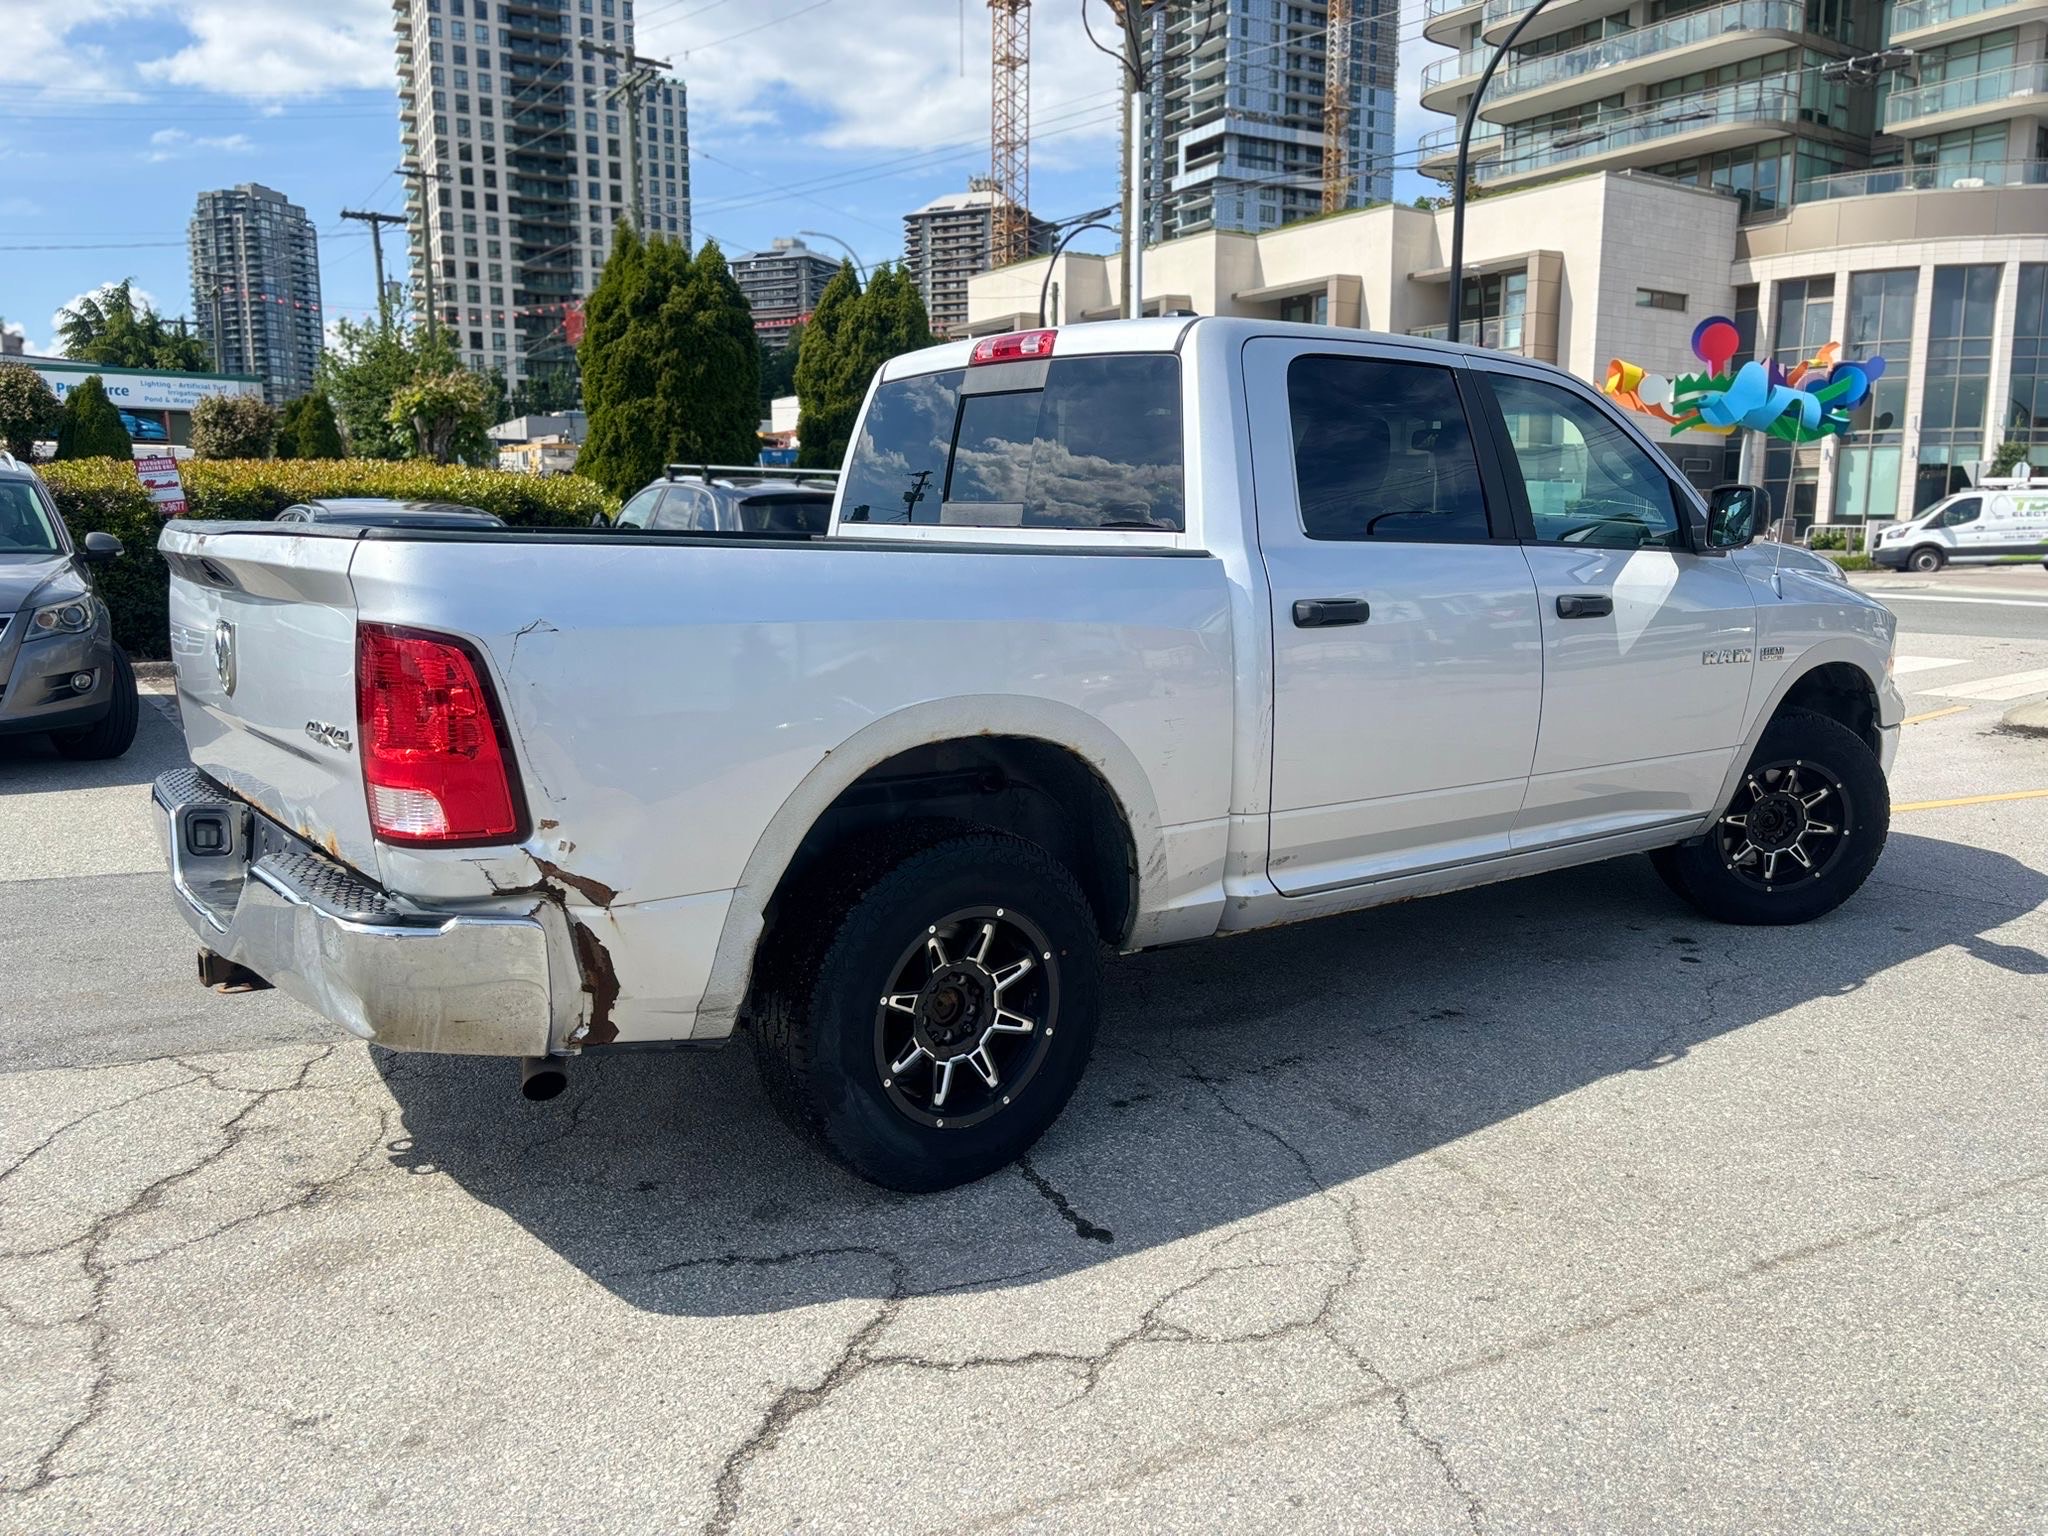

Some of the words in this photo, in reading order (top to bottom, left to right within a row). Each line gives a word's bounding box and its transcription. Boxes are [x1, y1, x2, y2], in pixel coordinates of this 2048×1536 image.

[140, 380, 171, 389] Lighting
[178, 382, 211, 390] Artificial
[212, 383, 227, 391] Turf
[144, 395, 163, 403] Pond
[1702, 648, 1752, 665] RAM
